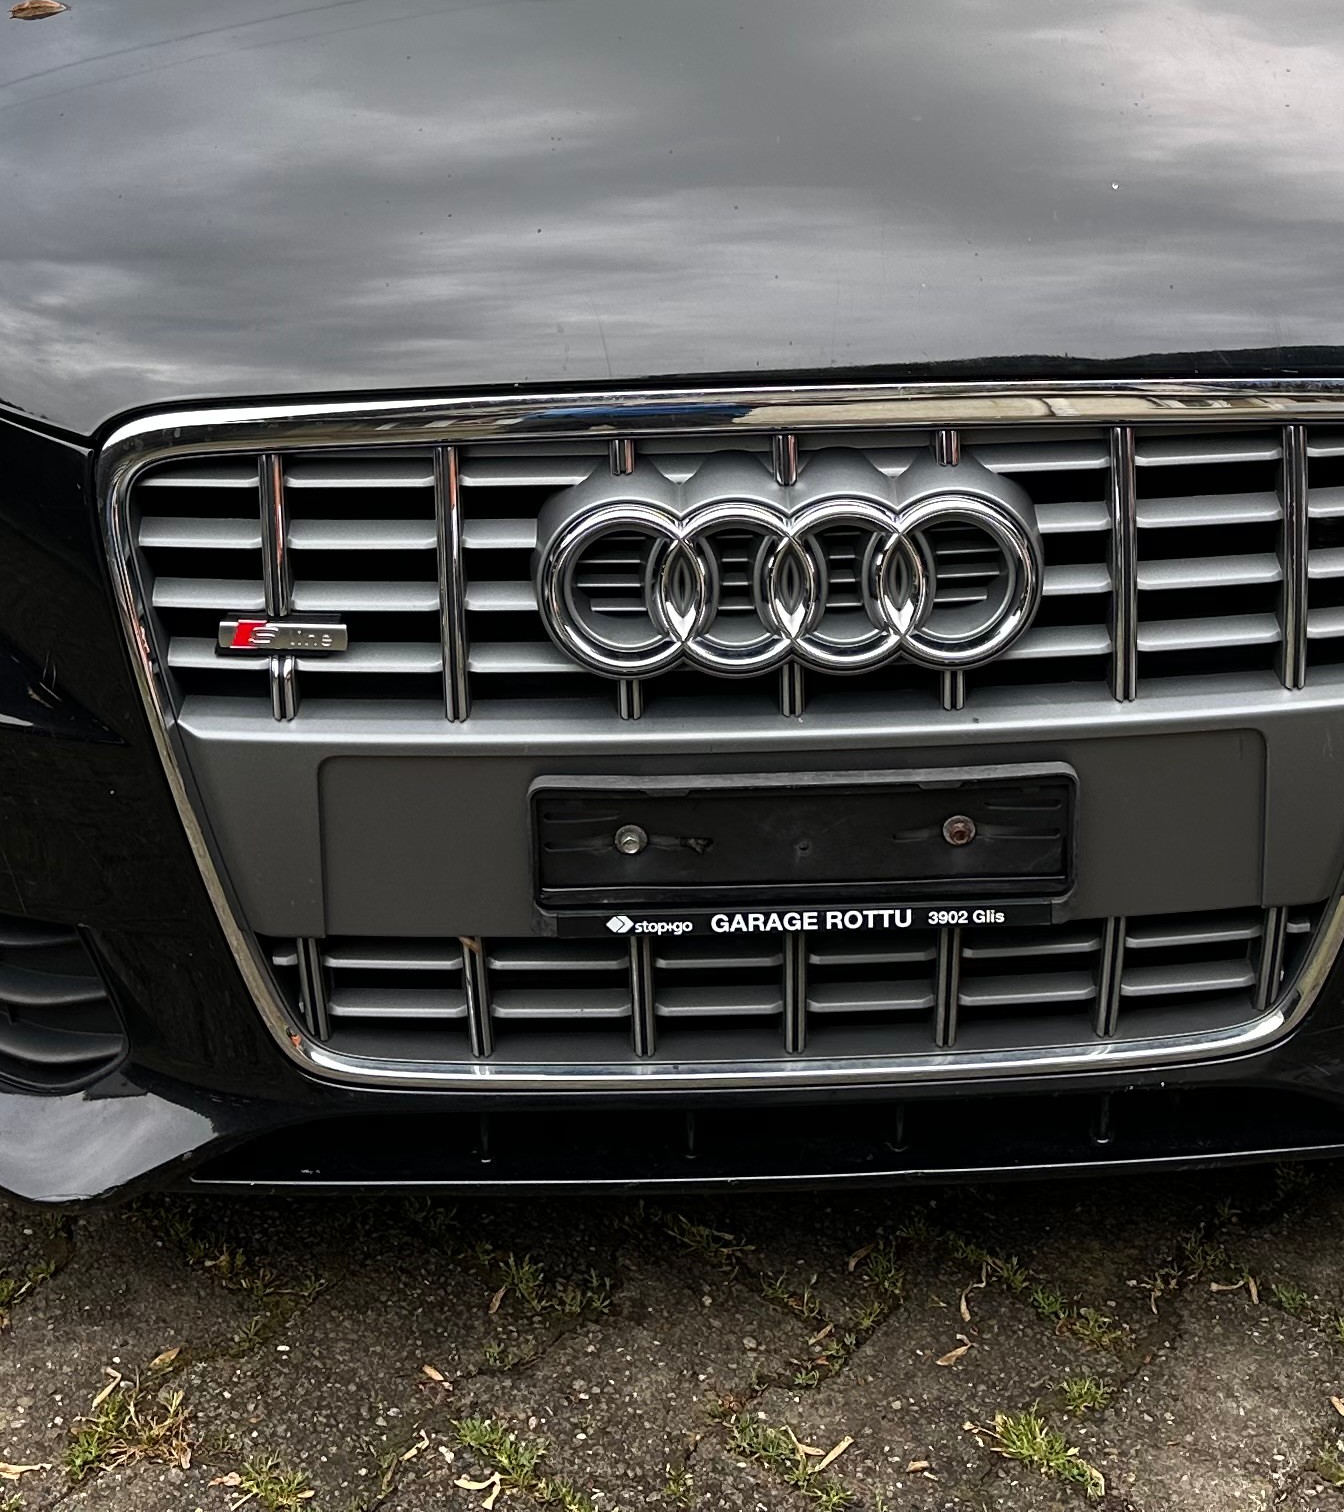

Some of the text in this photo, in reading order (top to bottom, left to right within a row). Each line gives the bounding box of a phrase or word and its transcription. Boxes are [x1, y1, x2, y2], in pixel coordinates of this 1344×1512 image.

[634, 908, 1006, 936] stop+go GARAGE ROTTU 3902 Glis
